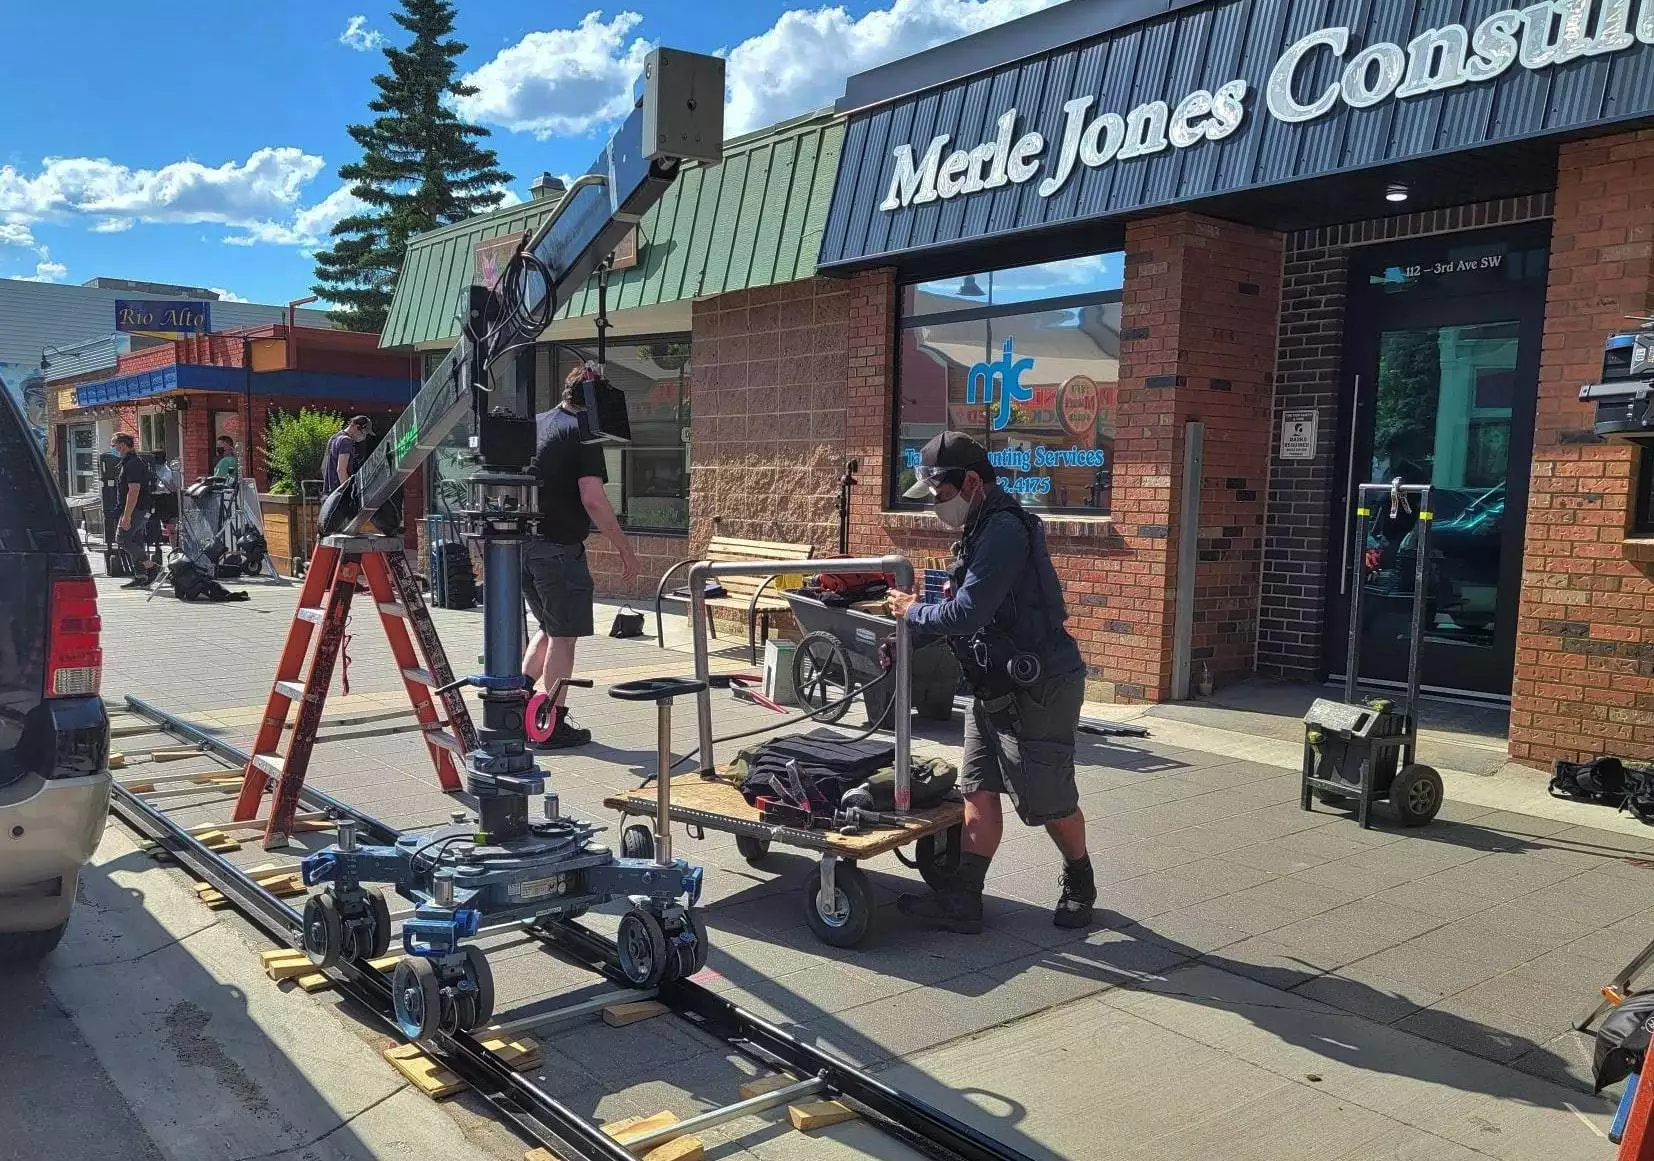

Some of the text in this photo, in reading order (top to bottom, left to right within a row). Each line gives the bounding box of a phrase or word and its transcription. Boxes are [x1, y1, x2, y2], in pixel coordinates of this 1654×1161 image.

[880, 108, 1044, 211] Merle
[1039, 79, 1247, 197] Jones
[1406, 265, 1421, 277] 112
[1433, 262, 1454, 274] 3rd
[1456, 260, 1478, 272] Ave
[1480, 256, 1502, 268] SW
[119, 307, 204, 327] Rio Alto
[904, 445, 1105, 472] Ta unting Services
[996, 475, 1051, 494] 2.4175
